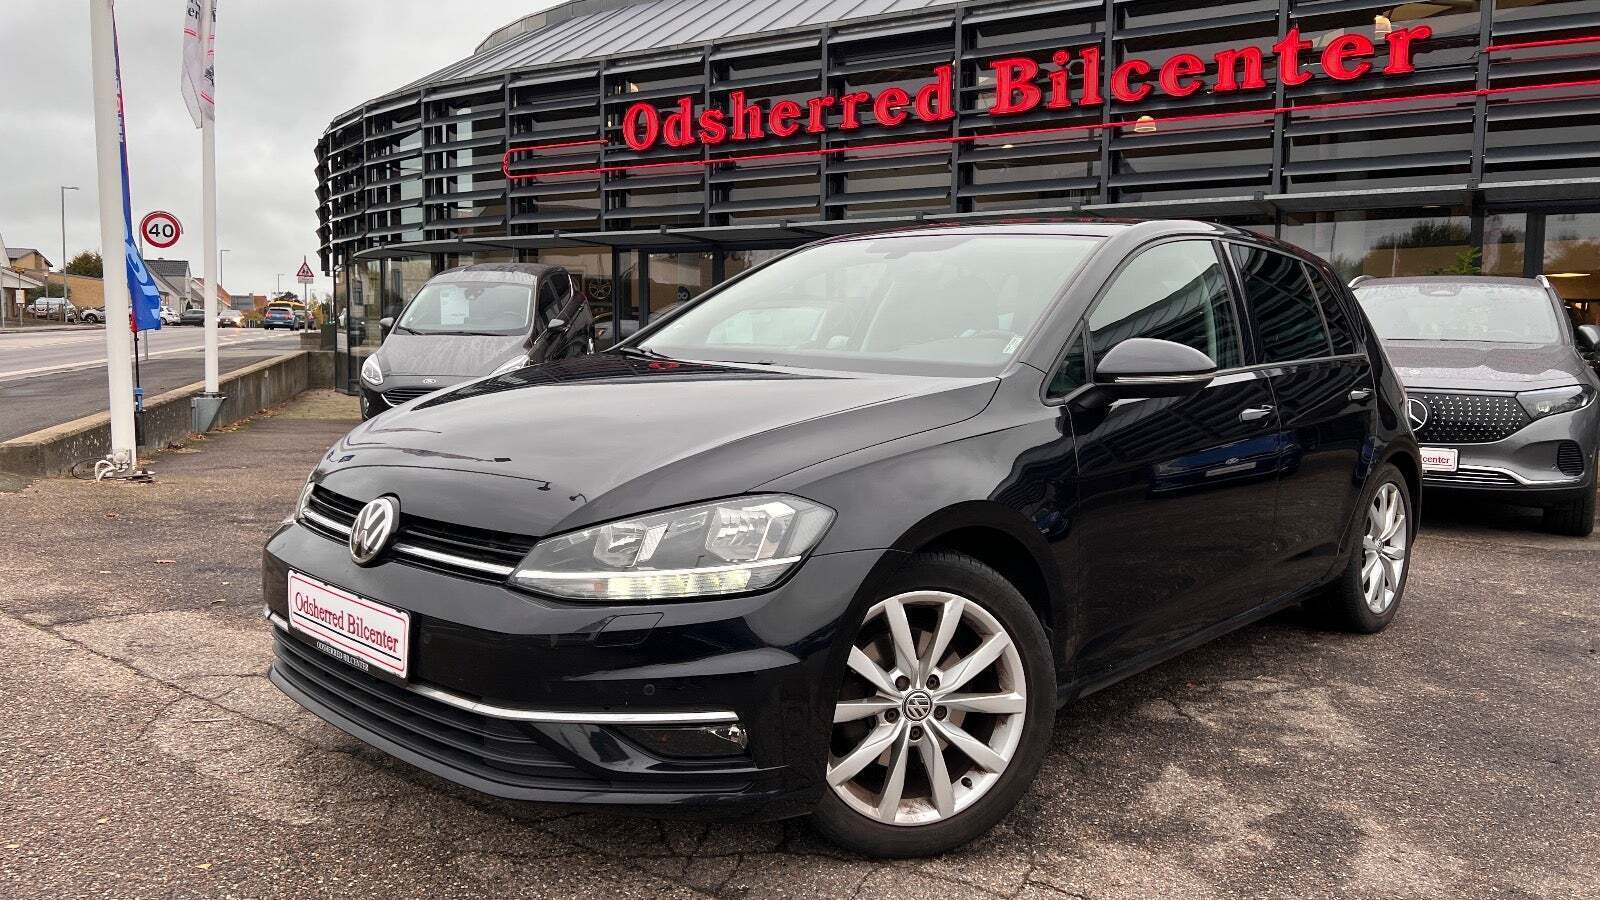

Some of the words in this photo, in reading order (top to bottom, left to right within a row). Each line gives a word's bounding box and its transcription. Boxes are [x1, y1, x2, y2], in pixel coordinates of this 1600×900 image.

[622, 64, 956, 151] Odsherred
[988, 24, 1433, 119] Bilcenter
[148, 223, 174, 238] 40
[295, 591, 345, 632] Odsherred
[347, 612, 399, 653] Bilcenter
